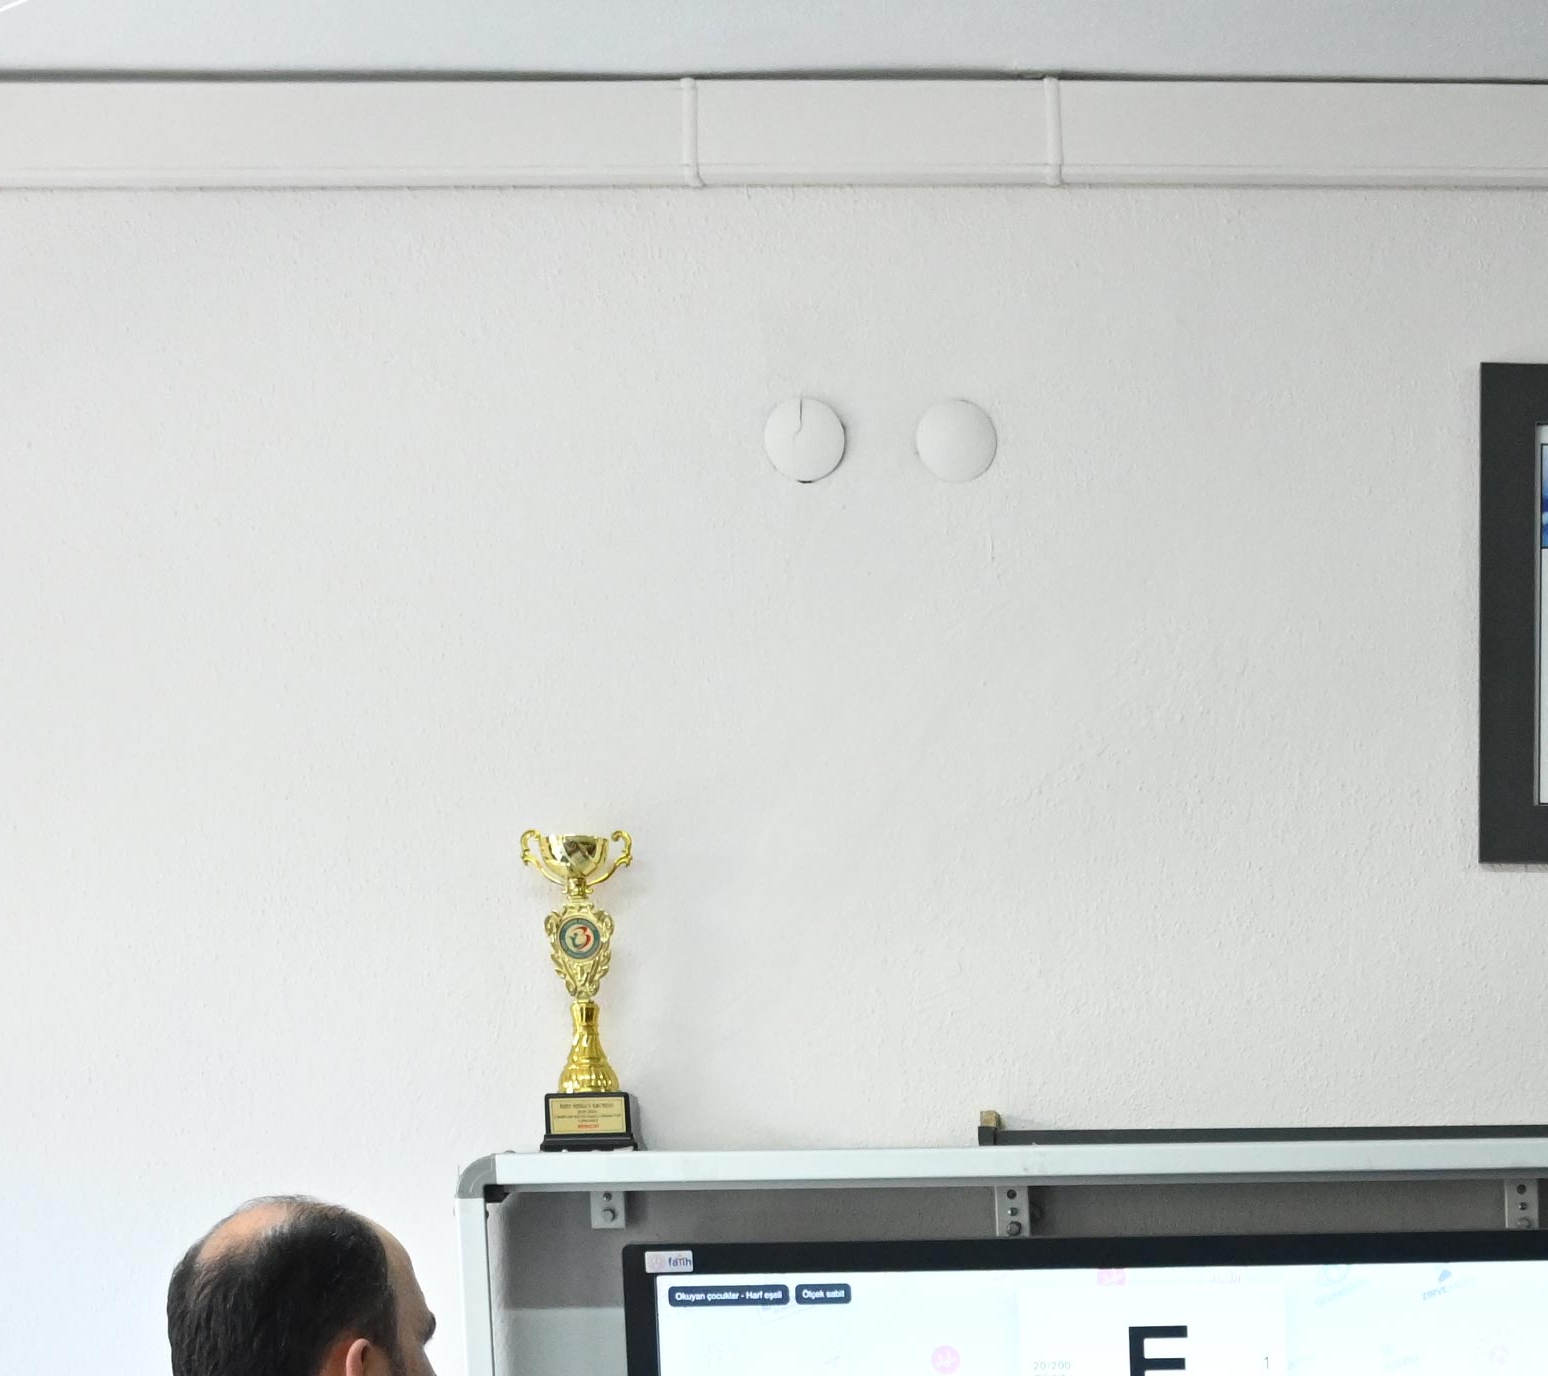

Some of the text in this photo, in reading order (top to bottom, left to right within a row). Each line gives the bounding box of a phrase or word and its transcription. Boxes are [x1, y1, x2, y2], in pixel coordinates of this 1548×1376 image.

[675, 1292, 705, 1302] Okuyan
[707, 1292, 739, 1301] çocuklar
[746, 1290, 763, 1300] Harf
